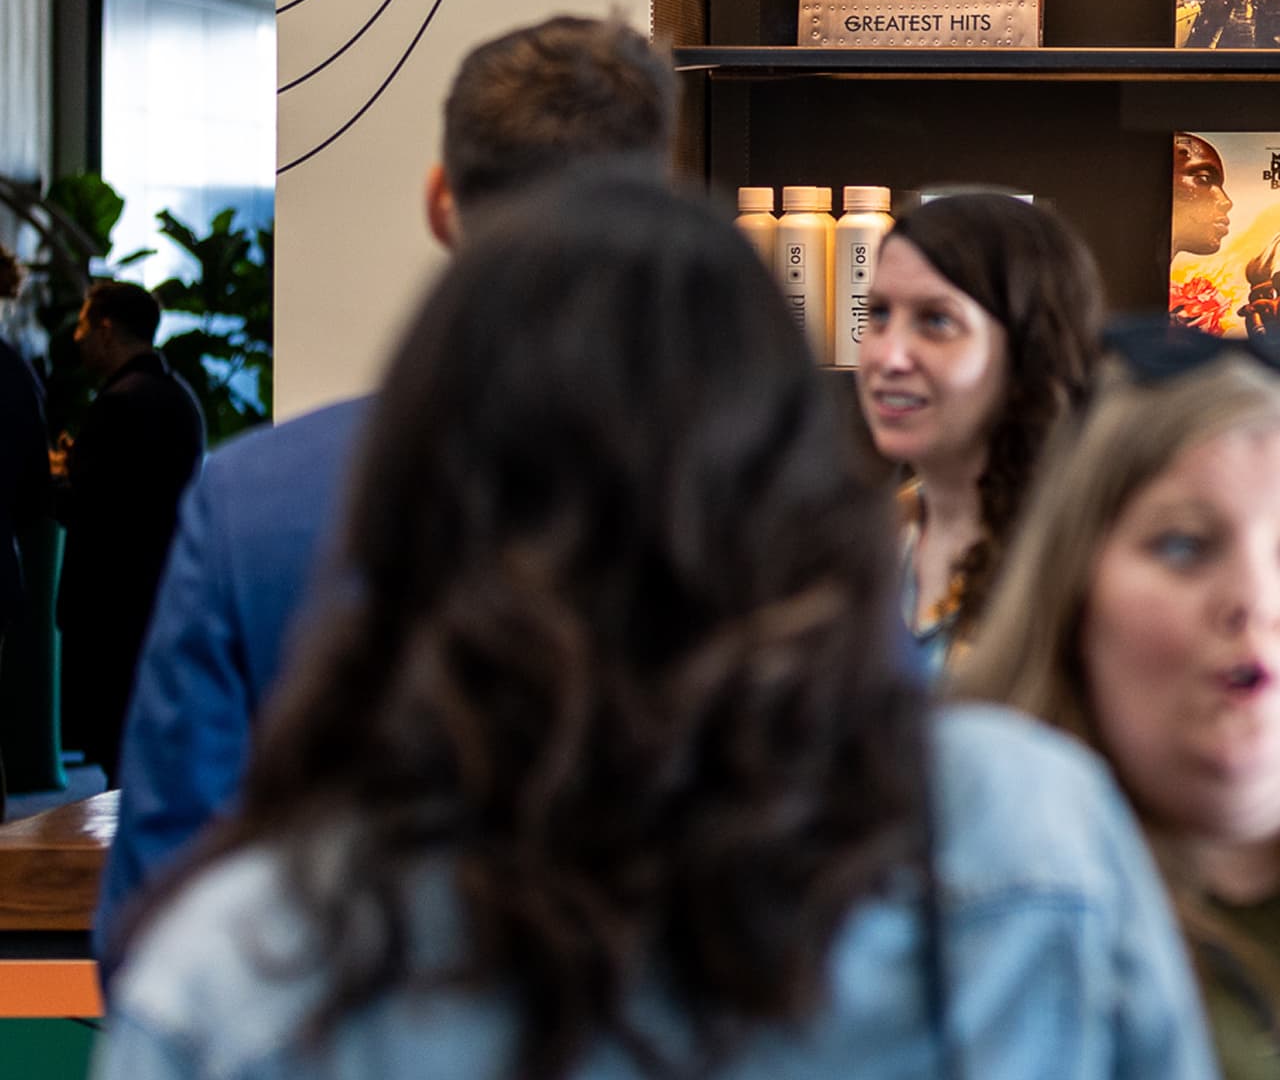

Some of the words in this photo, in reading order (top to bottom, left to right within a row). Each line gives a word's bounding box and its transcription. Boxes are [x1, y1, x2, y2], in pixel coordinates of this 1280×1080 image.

[844, 15, 943, 32] GREATEST
[950, 14, 991, 31] HITS
[790, 246, 801, 264] OS
[855, 246, 866, 264] OS
